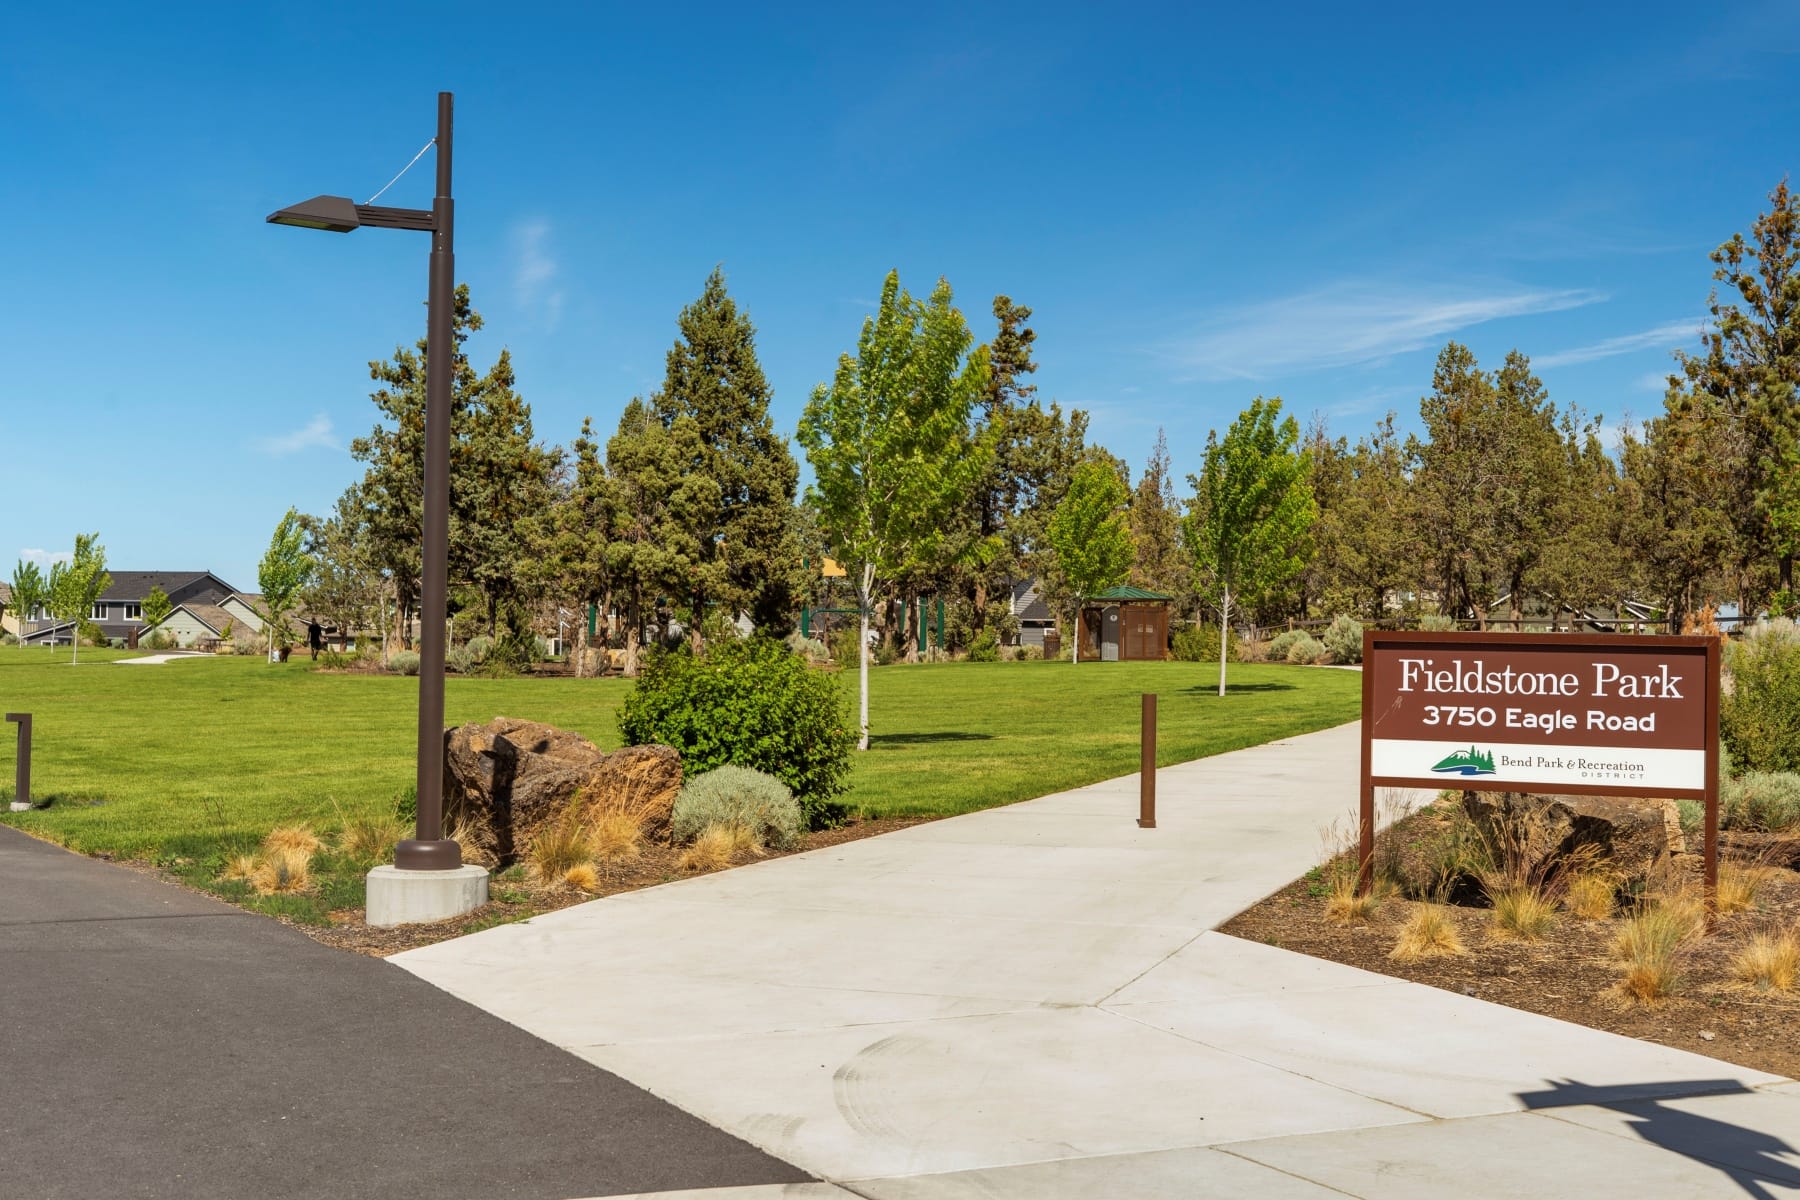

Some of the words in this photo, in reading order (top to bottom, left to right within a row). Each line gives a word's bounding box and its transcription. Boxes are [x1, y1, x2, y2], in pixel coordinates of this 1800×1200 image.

[1398, 659, 1579, 697] Fieldstone
[1591, 662, 1685, 699] Park
[1422, 705, 1497, 727] 3750
[1505, 707, 1578, 735] Eagle
[1586, 710, 1656, 732] Road
[1501, 755, 1532, 768] Bend
[1537, 757, 1564, 769] Park
[1566, 760, 1576, 770] &
[1577, 758, 1645, 772] Recreation
[1581, 771, 1645, 779] DISTRICT
